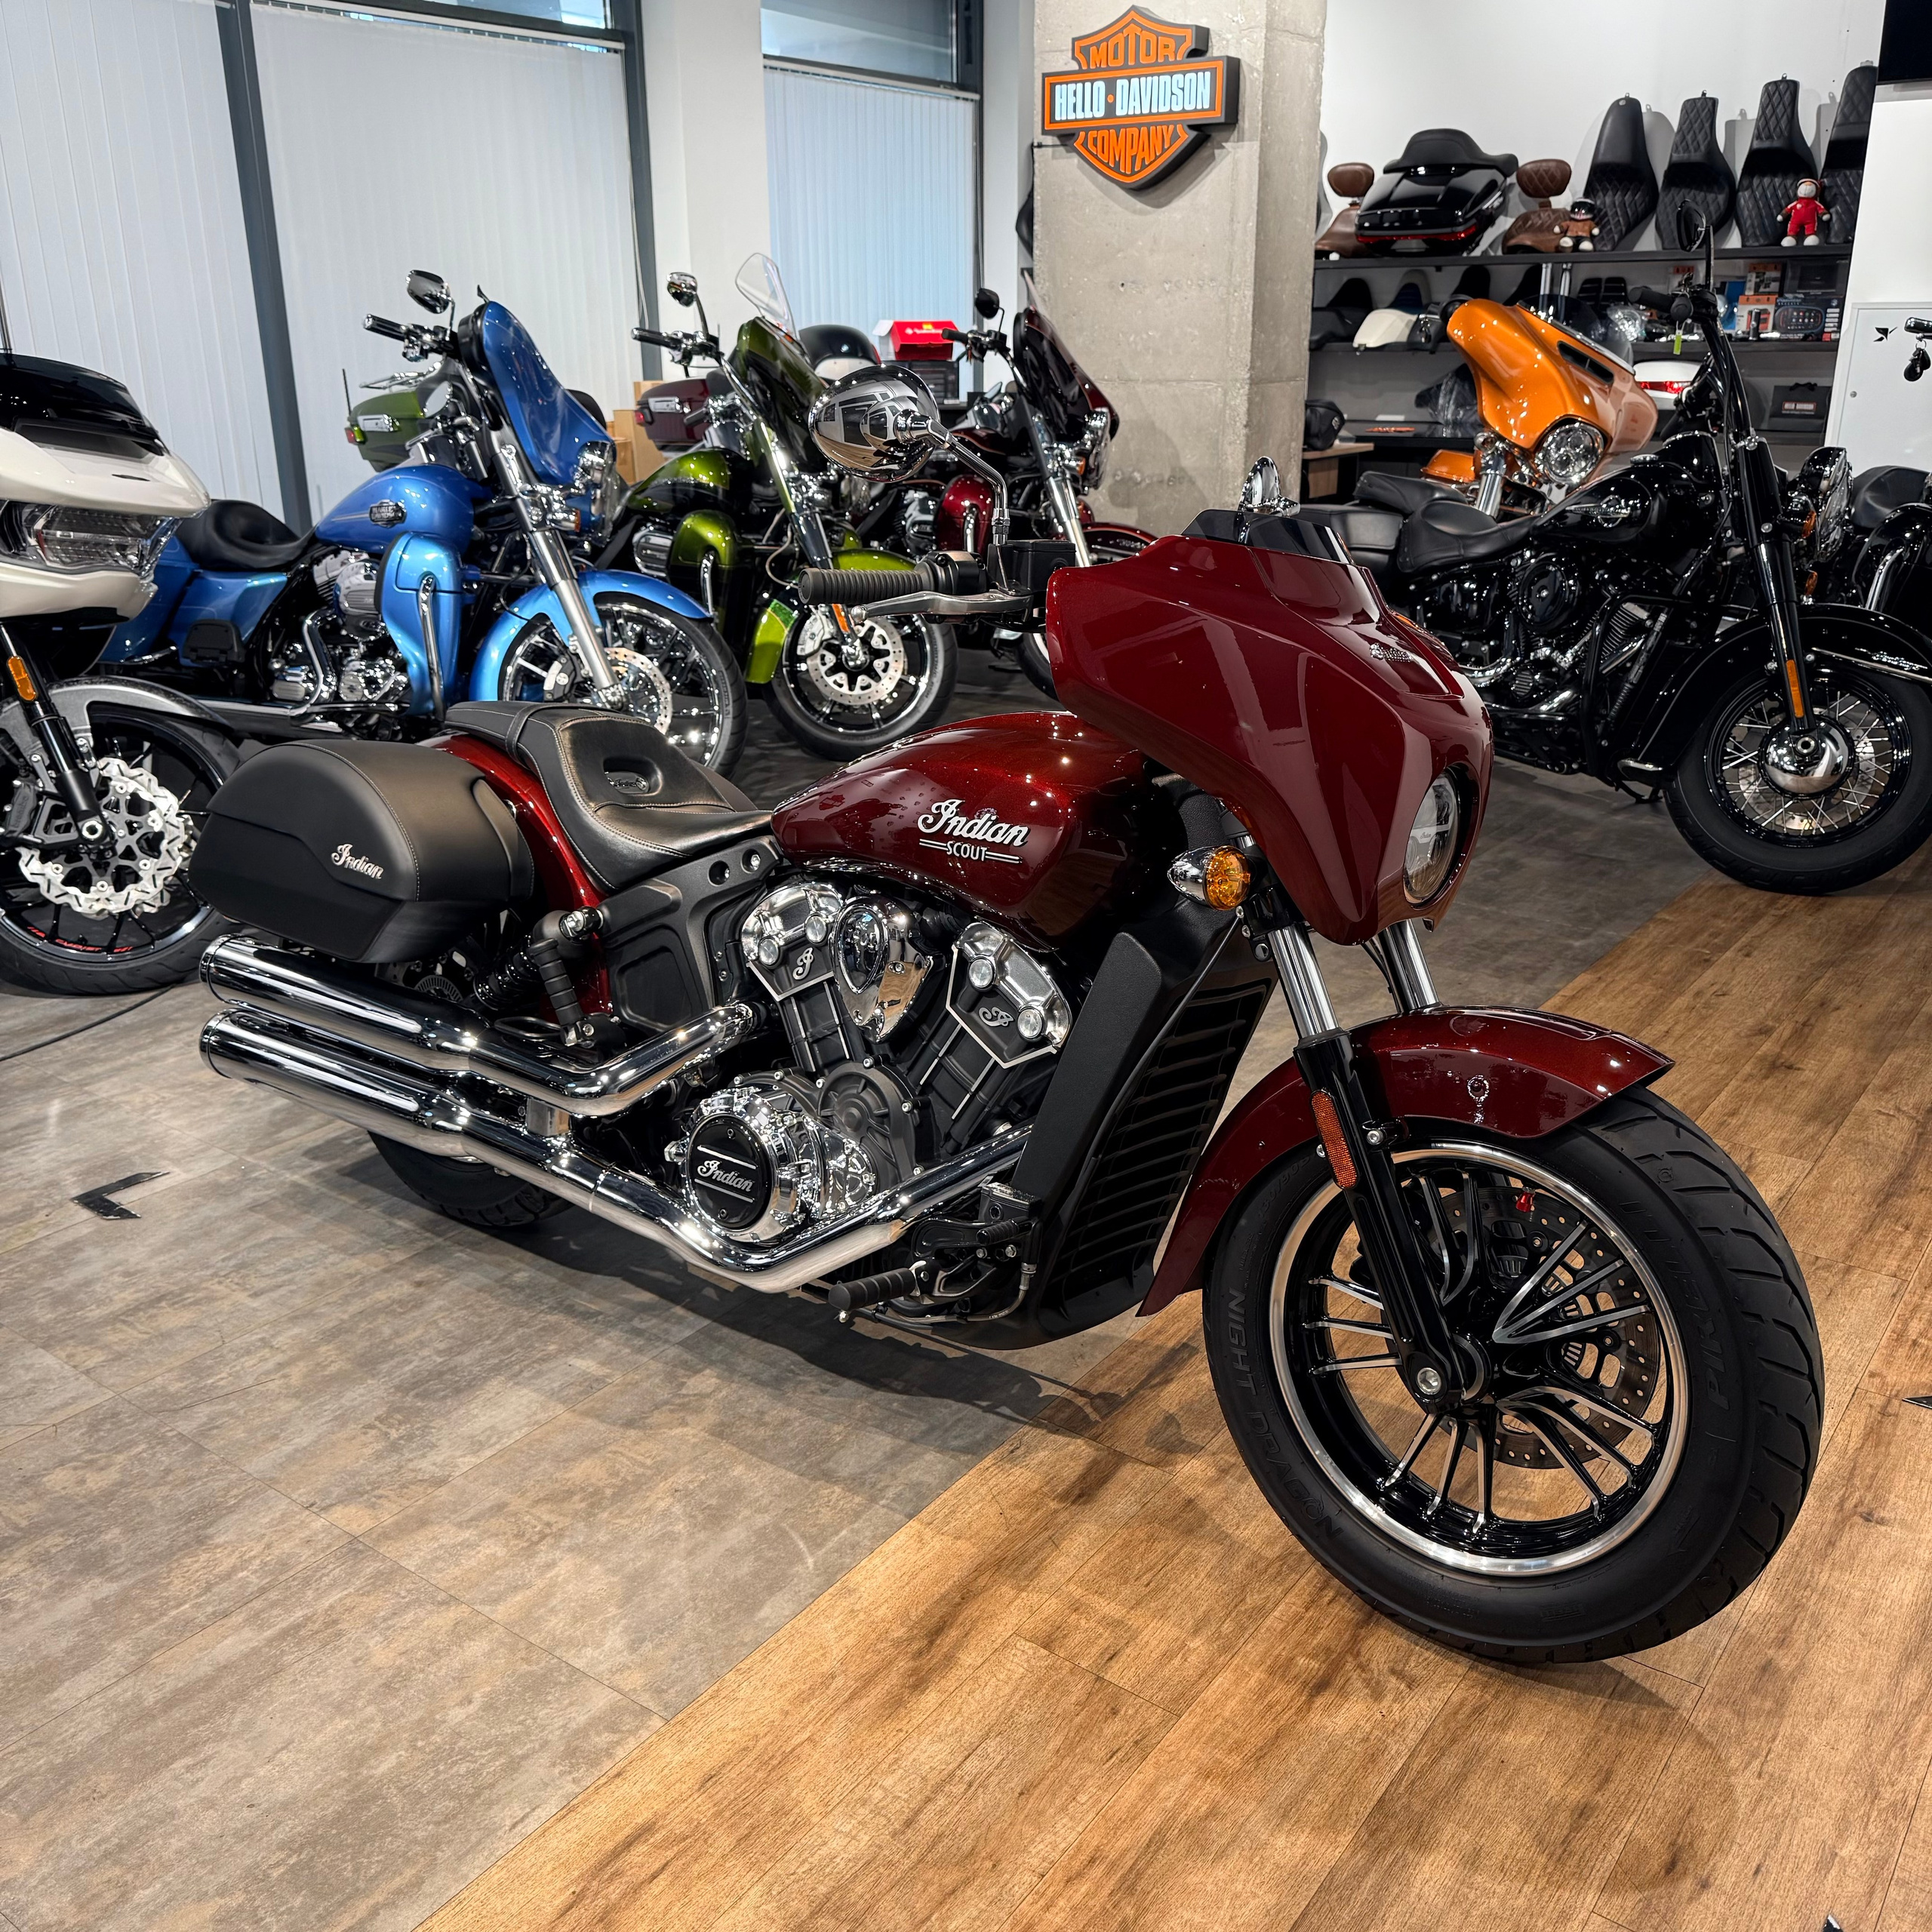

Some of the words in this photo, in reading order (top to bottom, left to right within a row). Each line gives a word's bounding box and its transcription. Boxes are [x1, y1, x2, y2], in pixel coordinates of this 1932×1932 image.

[1090, 23, 1176, 69] MOTOR
[1055, 80, 1106, 121] HELLO
[1115, 71, 1211, 116] DAVIDSON
[1088, 125, 1174, 174] COMPANY
[917, 798, 1031, 847] Indian
[331, 843, 384, 880] Indian
[946, 840, 988, 861] SCOUT
[697, 1160, 754, 1192] Indian
[1228, 1287, 1257, 1396] NIGHT
[1246, 1411, 1344, 1540] DRAGON
